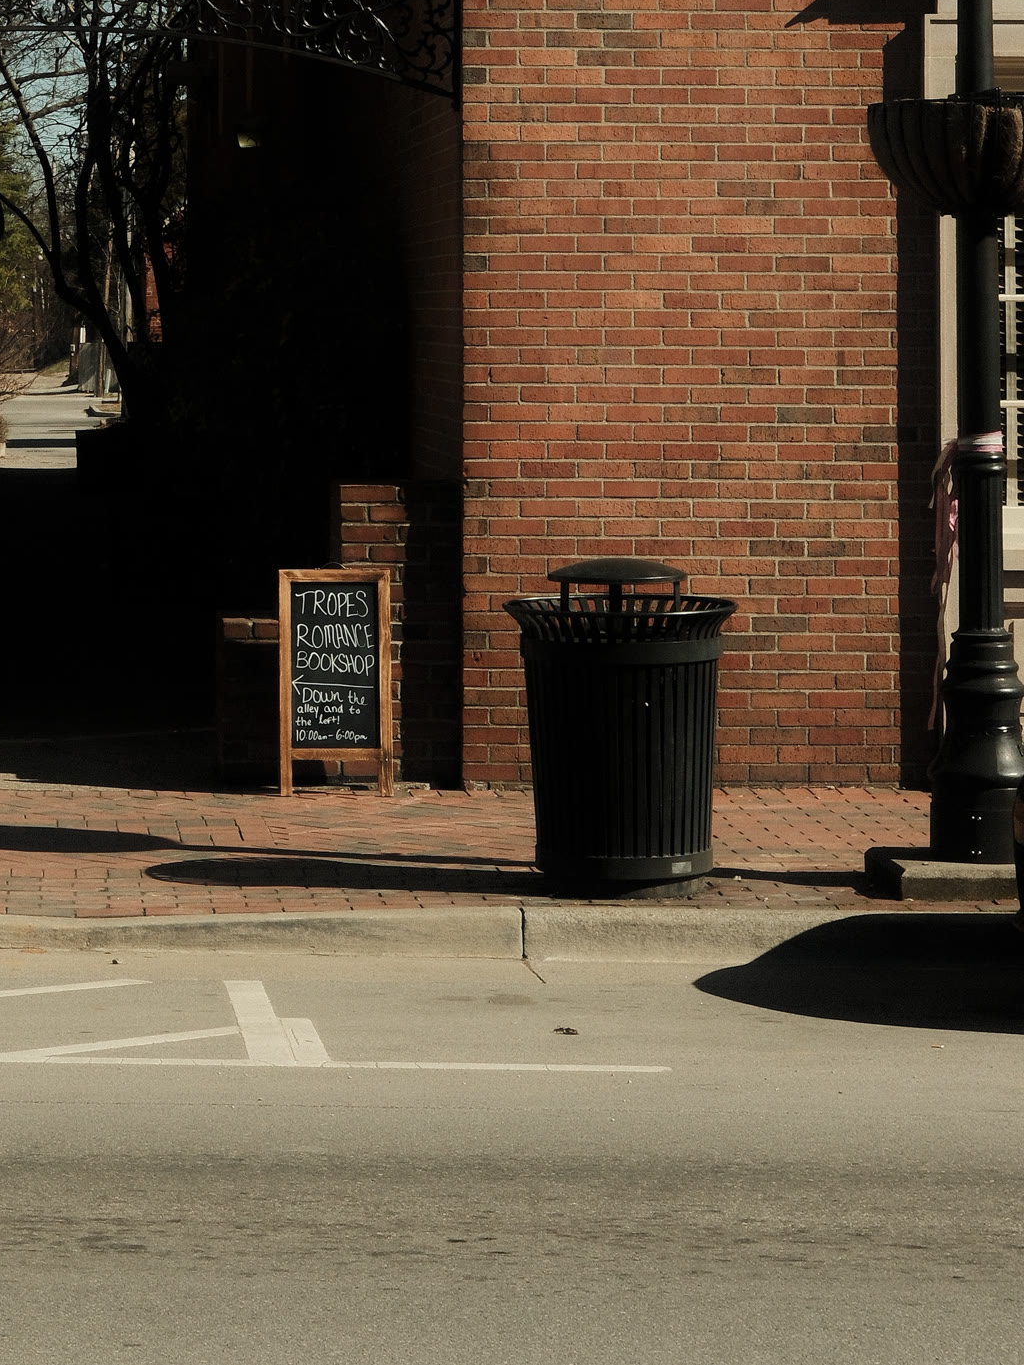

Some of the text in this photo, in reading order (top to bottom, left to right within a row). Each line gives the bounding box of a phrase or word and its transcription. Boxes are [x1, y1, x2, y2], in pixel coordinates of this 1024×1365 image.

[295, 589, 369, 618] TROPES
[296, 623, 375, 649] ROMANCE
[296, 650, 375, 677] BOOKSHOP
[348, 690, 368, 706] the
[295, 716, 312, 726] the
[296, 703, 361, 718] alley and to
